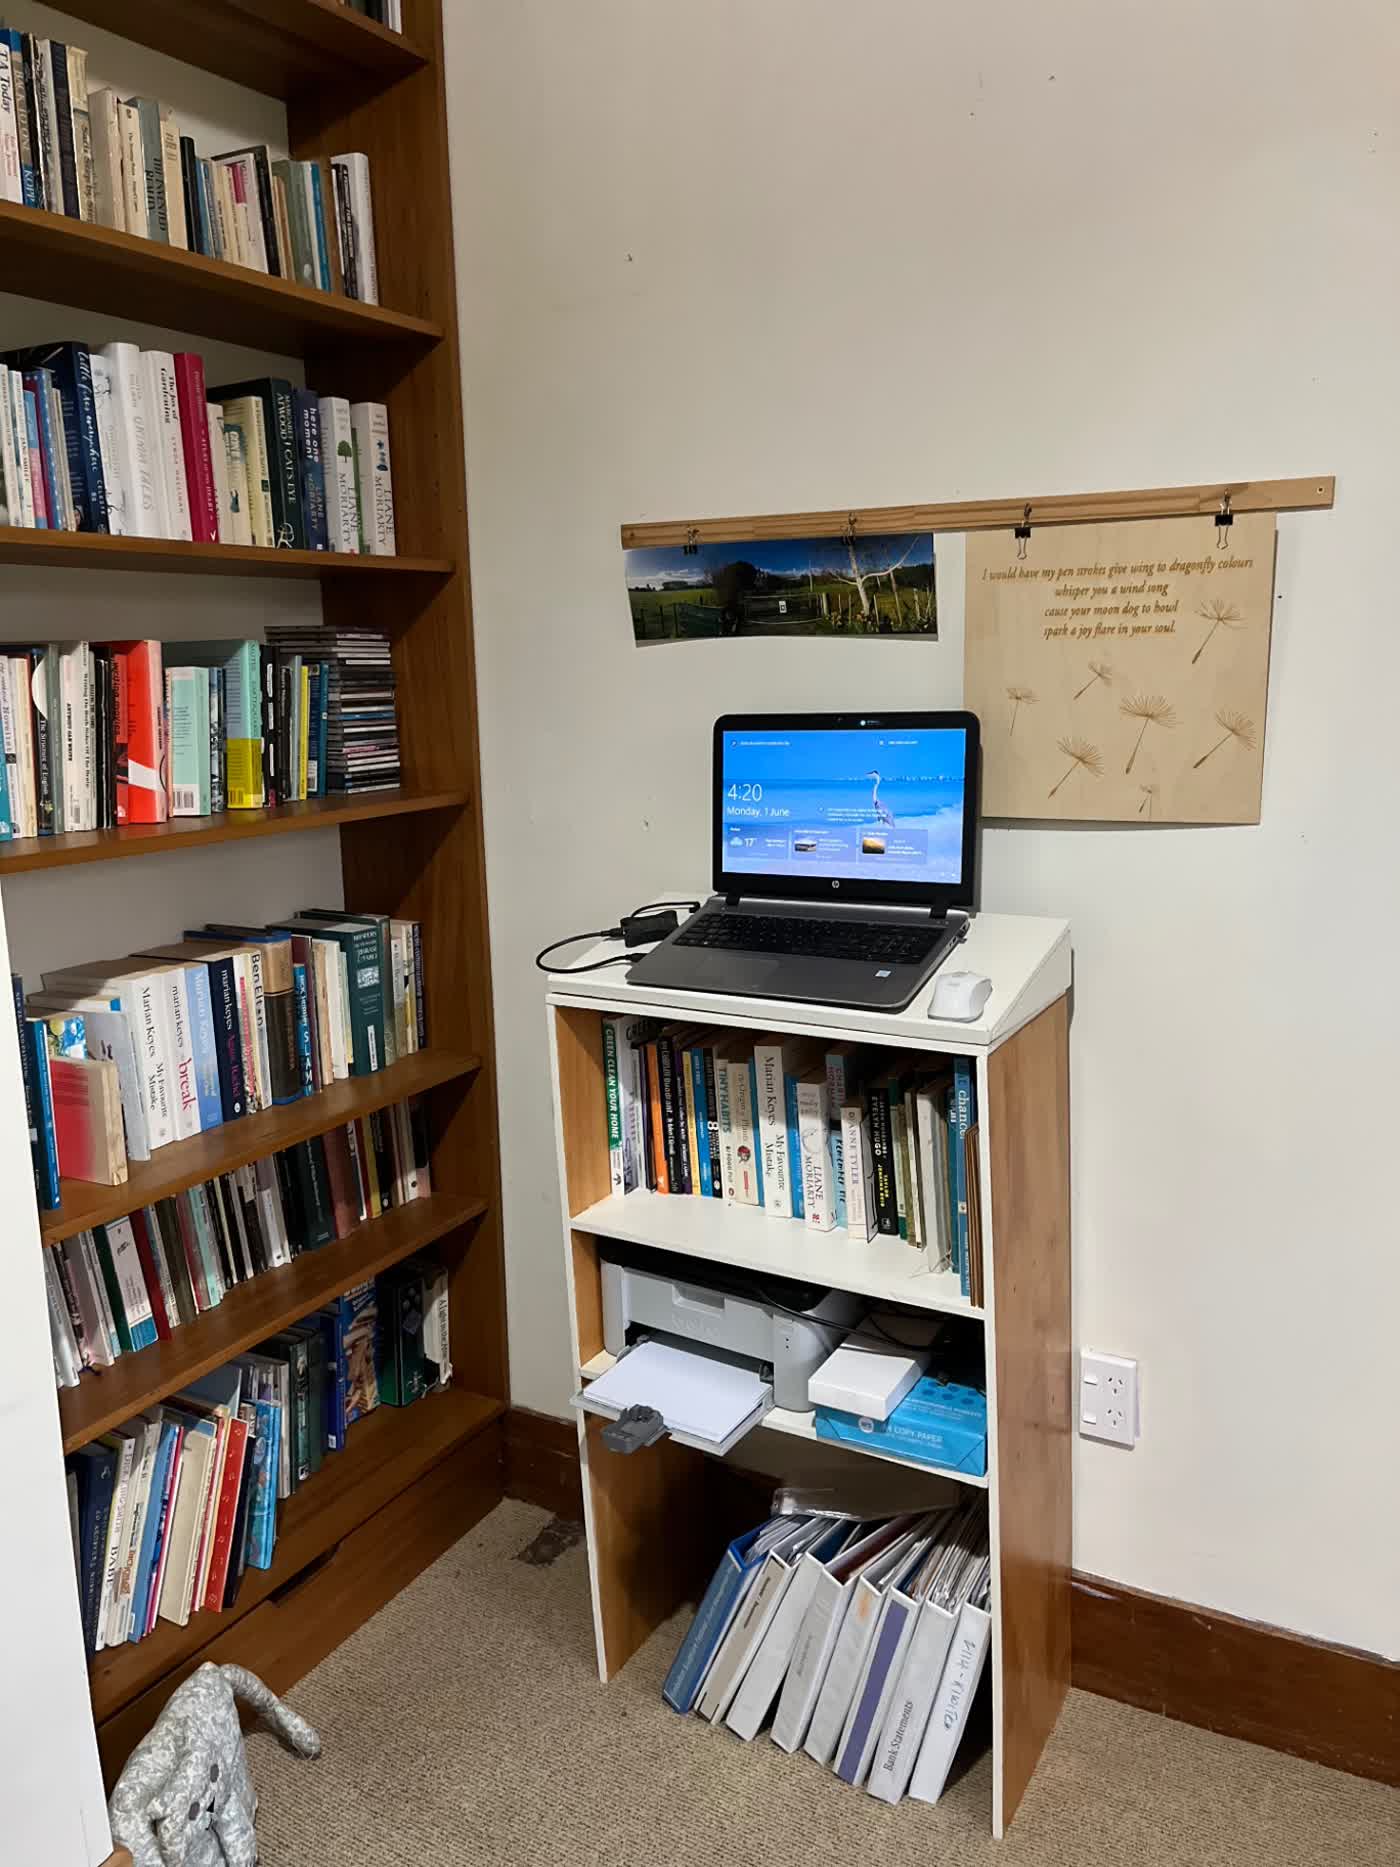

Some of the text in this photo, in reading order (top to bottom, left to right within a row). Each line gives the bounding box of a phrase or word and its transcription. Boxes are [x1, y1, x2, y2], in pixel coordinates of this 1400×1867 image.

[0, 51, 12, 113] TA Today
[14, 69, 25, 100] BACK
[19, 106, 28, 123] TO
[24, 169, 35, 202] KOPP
[145, 169, 156, 210] REALITY
[155, 177, 166, 231] INVENTED
[77, 383, 93, 412] fires
[160, 368, 172, 424] Gardening
[276, 392, 287, 440] ATWOOD
[284, 394, 294, 440] MARGARET
[83, 415, 100, 472] everywhere
[303, 408, 313, 460] moment
[309, 407, 320, 463] here one
[140, 469, 154, 512] TALES
[205, 487, 214, 512] HEART
[287, 482, 297, 505] EYE
[307, 473, 318, 530] MORIARTY
[315, 487, 324, 519] LIANE
[338, 472, 351, 546] MORIARTY
[347, 486, 358, 534] LIANE
[374, 476, 386, 546] MORIARTY
[384, 489, 394, 536] LIANE
[989, 566, 1017, 580] would
[1018, 566, 1039, 579] have
[1041, 568, 1055, 583] my
[1057, 568, 1074, 581] pen
[1077, 564, 1106, 578] strokes
[1108, 563, 1127, 579] give
[1130, 562, 1154, 578] wing
[1157, 562, 1167, 573] to
[1168, 556, 1216, 574] dragonfly
[1217, 557, 1253, 570] colours
[1055, 581, 1169, 600] whisper you a wind song
[1043, 621, 1176, 640] spark a joy flare in your soul.
[1044, 599, 1179, 619] cause your moon dog to howl
[40, 719, 48, 732] The
[40, 733, 48, 761] Structure
[41, 772, 49, 795] English
[727, 784, 762, 802] 4:20
[727, 806, 762, 817] Monday,
[770, 807, 790, 817] June
[221, 968, 233, 1031] marian keyes
[251, 953, 265, 1027] Ben Elton
[16, 1009, 25, 1044] ZEALAND
[142, 987, 157, 1058] Marian Keyes
[171, 985, 185, 1048] marian keyes
[194, 971, 209, 1054] Marian Keyes
[304, 1031, 313, 1082] SLAM
[147, 1075, 157, 1111] Mistake
[154, 1062, 169, 1118] My Favourite
[177, 1057, 196, 1111] break
[605, 1028, 620, 1139] GREEN CLEAN YOUR HOME
[719, 1068, 731, 1134] TINY HABITS
[737, 1083, 747, 1110] Origin
[763, 1056, 778, 1127] Marian Keyes
[707, 1120, 719, 1132] 8
[740, 1119, 749, 1142] Plants
[871, 1096, 882, 1156] EVELYN HUGO
[764, 1142, 775, 1178] Mistake
[775, 1134, 786, 1191] My Favourite
[805, 1155, 816, 1209] MORIARTY
[850, 1154, 860, 1185] TYLER
[813, 1166, 823, 1200] LIANE
[894, 1427, 944, 1443] COPY PAPER
[106, 1545, 120, 1585] BABE
[882, 1700, 914, 1772] Bank Statements
